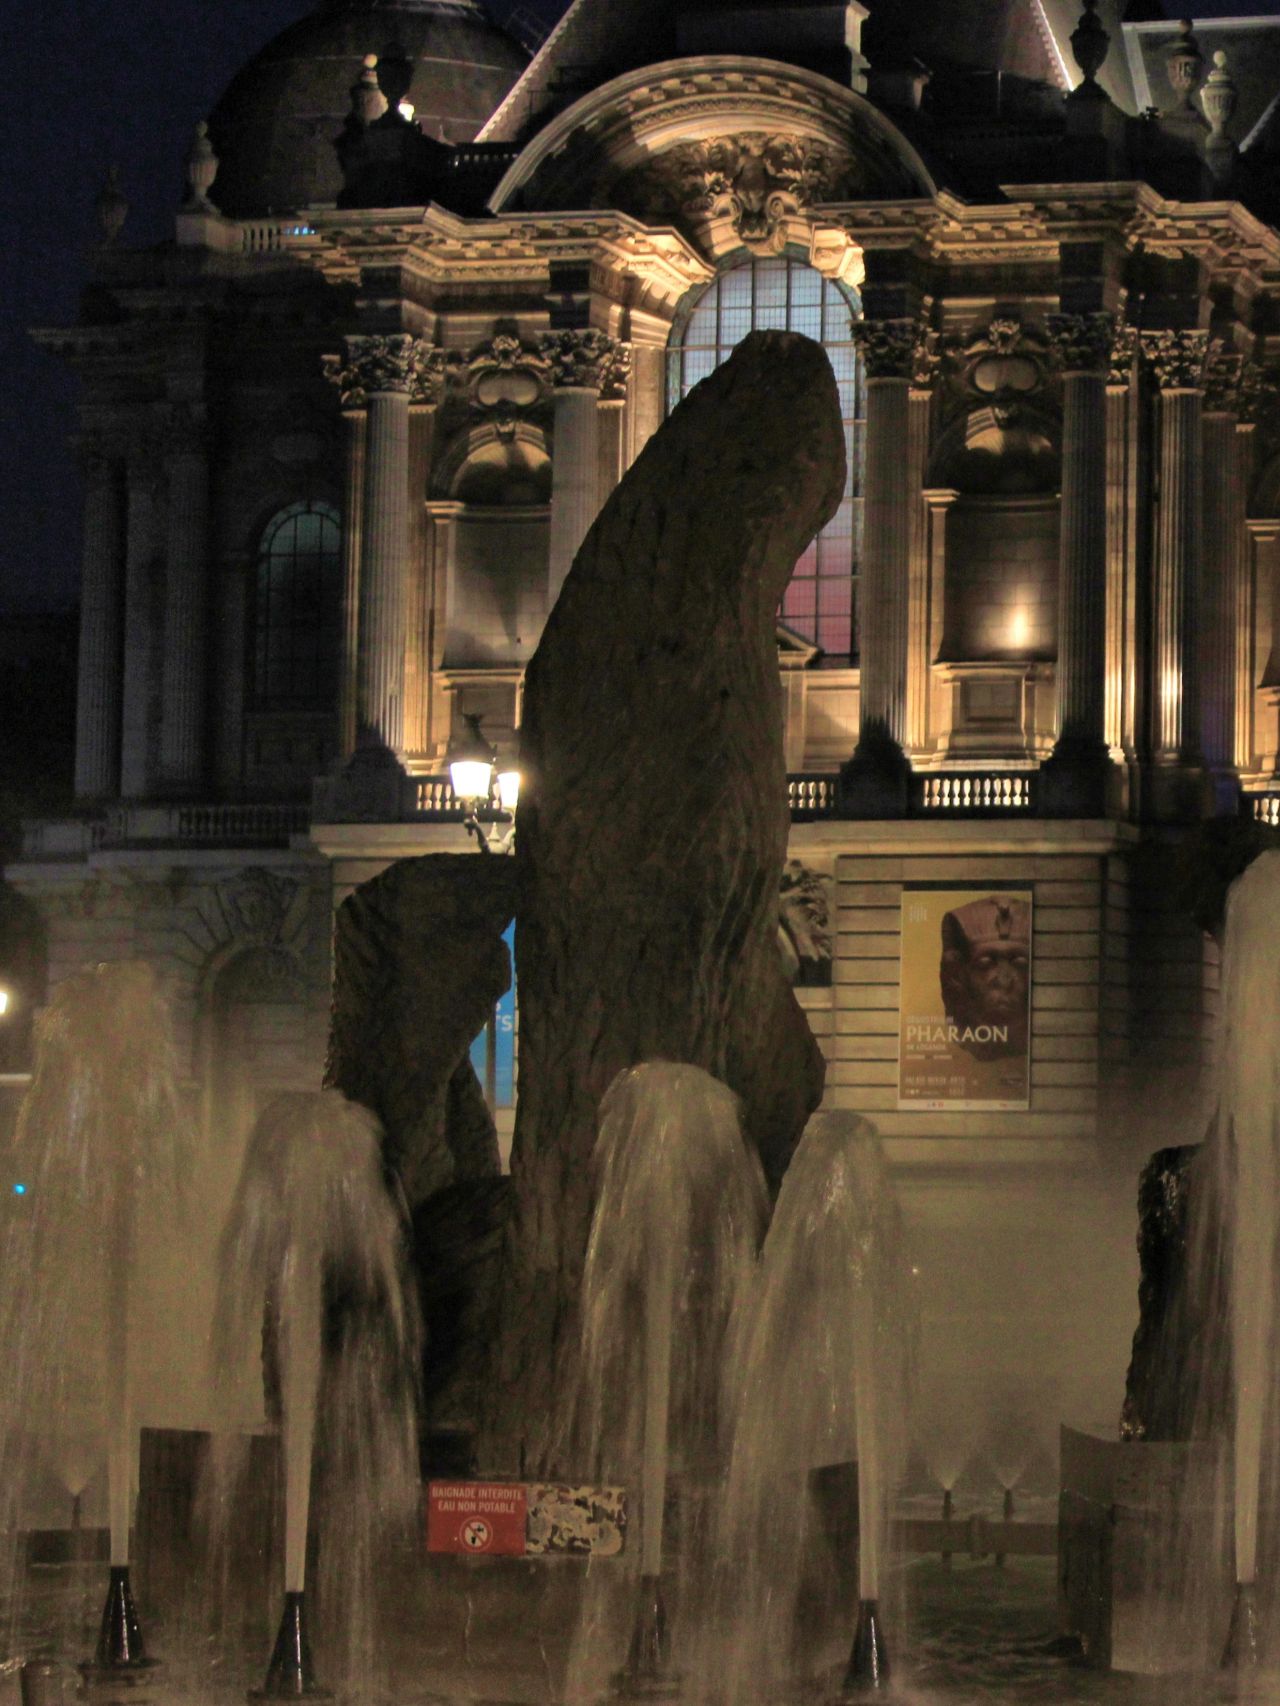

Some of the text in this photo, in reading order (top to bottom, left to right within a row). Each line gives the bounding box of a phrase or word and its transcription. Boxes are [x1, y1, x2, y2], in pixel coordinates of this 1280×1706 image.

[906, 1025, 1008, 1042] PHARAON
[432, 1486, 522, 1500] BAIGNADE INTERDITE
[438, 1500, 516, 1513] EAU NON POTABLE
